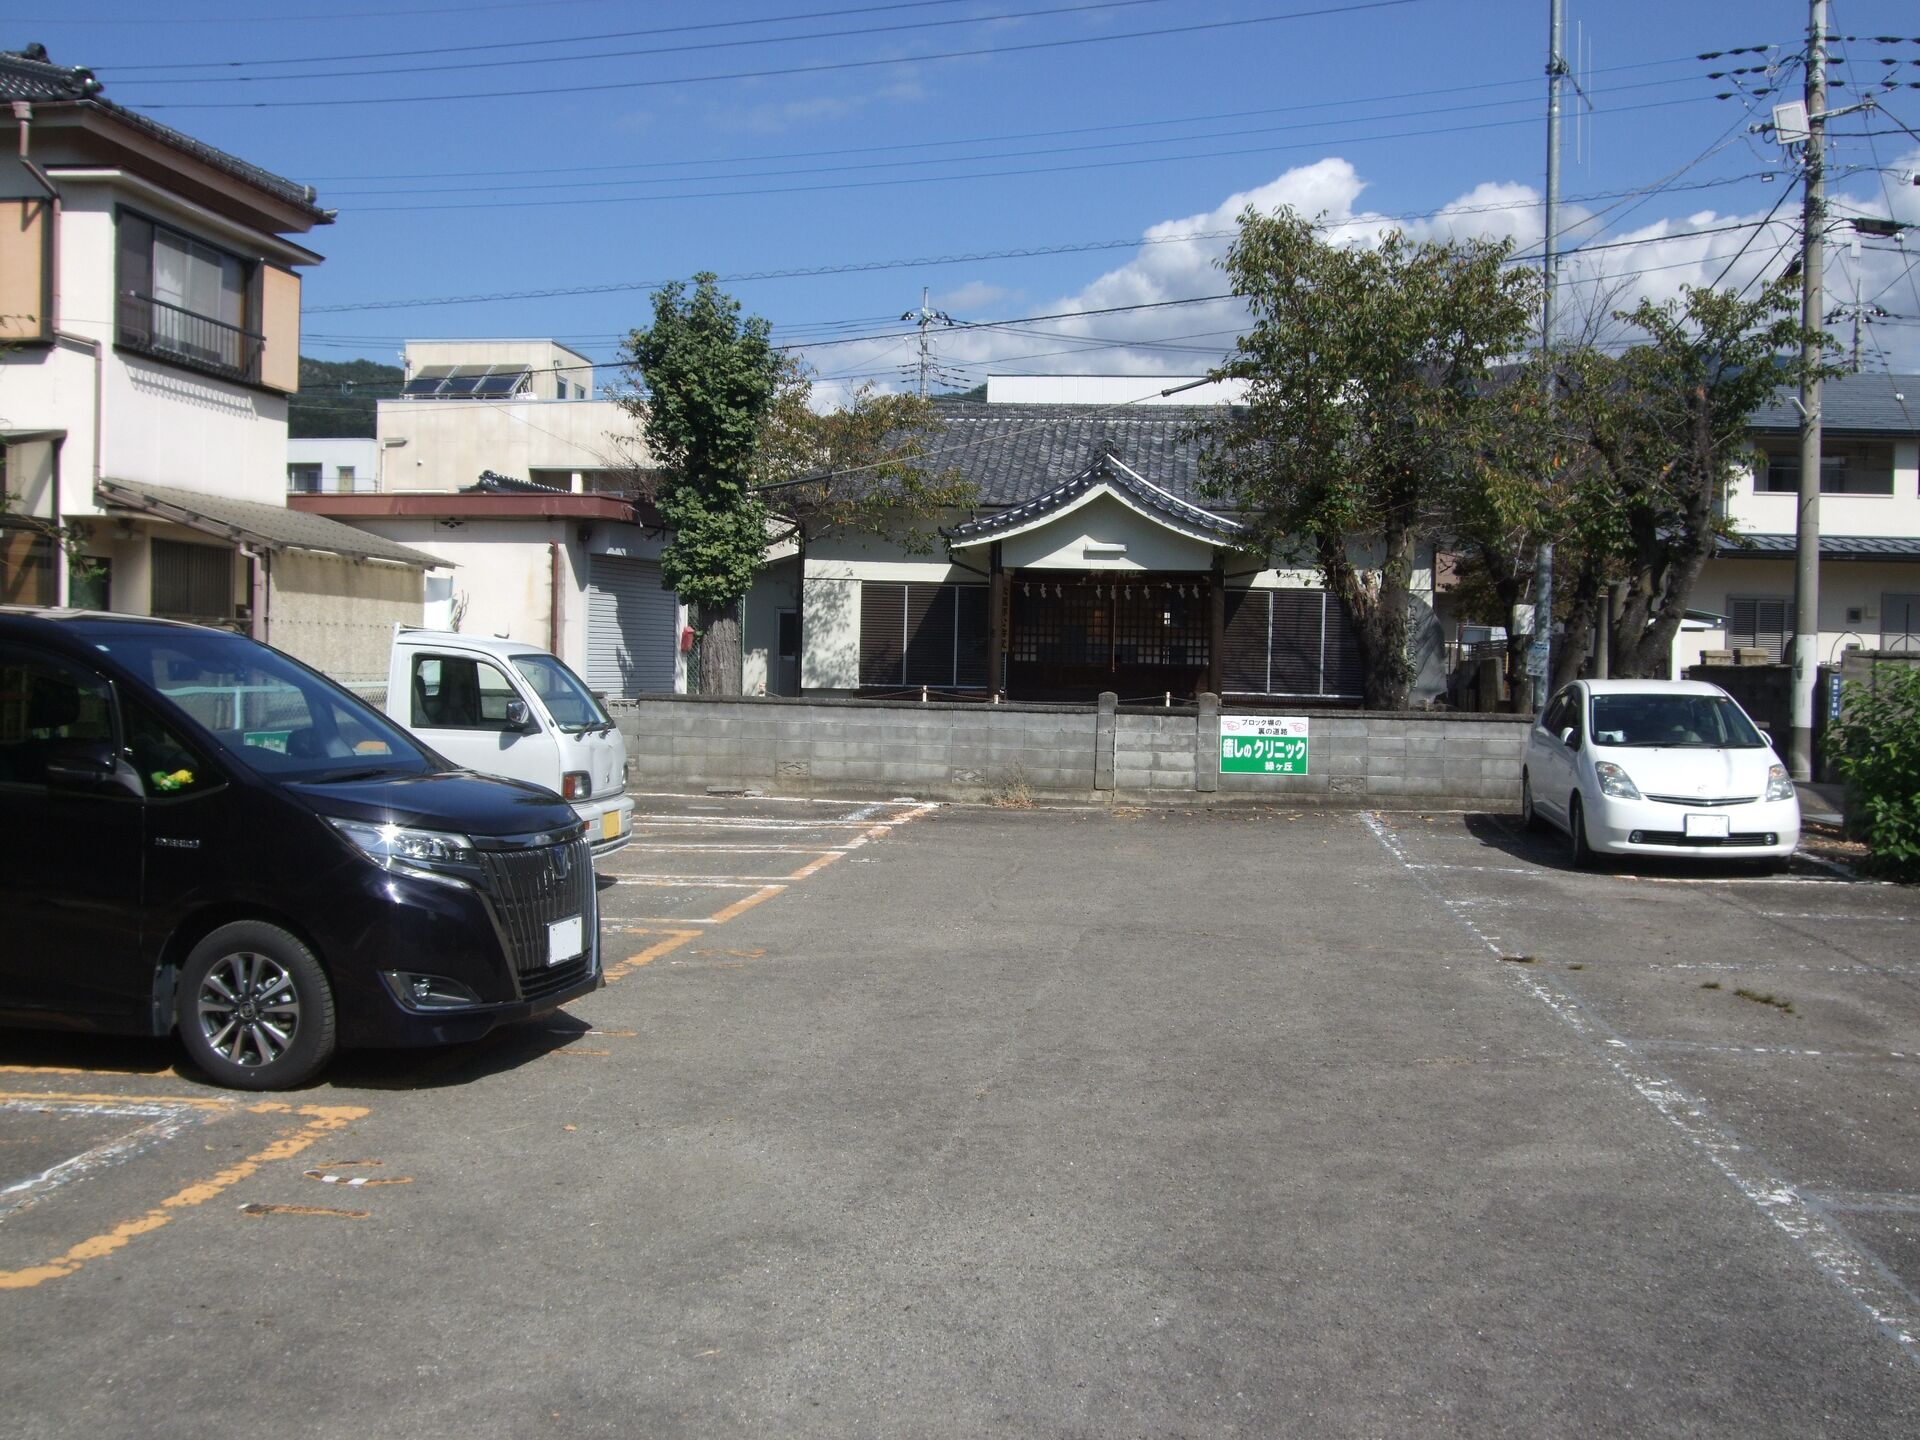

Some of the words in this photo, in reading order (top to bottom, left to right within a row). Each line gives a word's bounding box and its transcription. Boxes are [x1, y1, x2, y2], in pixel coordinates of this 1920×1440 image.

[1258, 727, 1288, 736] 裏の道路
[1222, 738, 1306, 760] 癒しのクリニック
